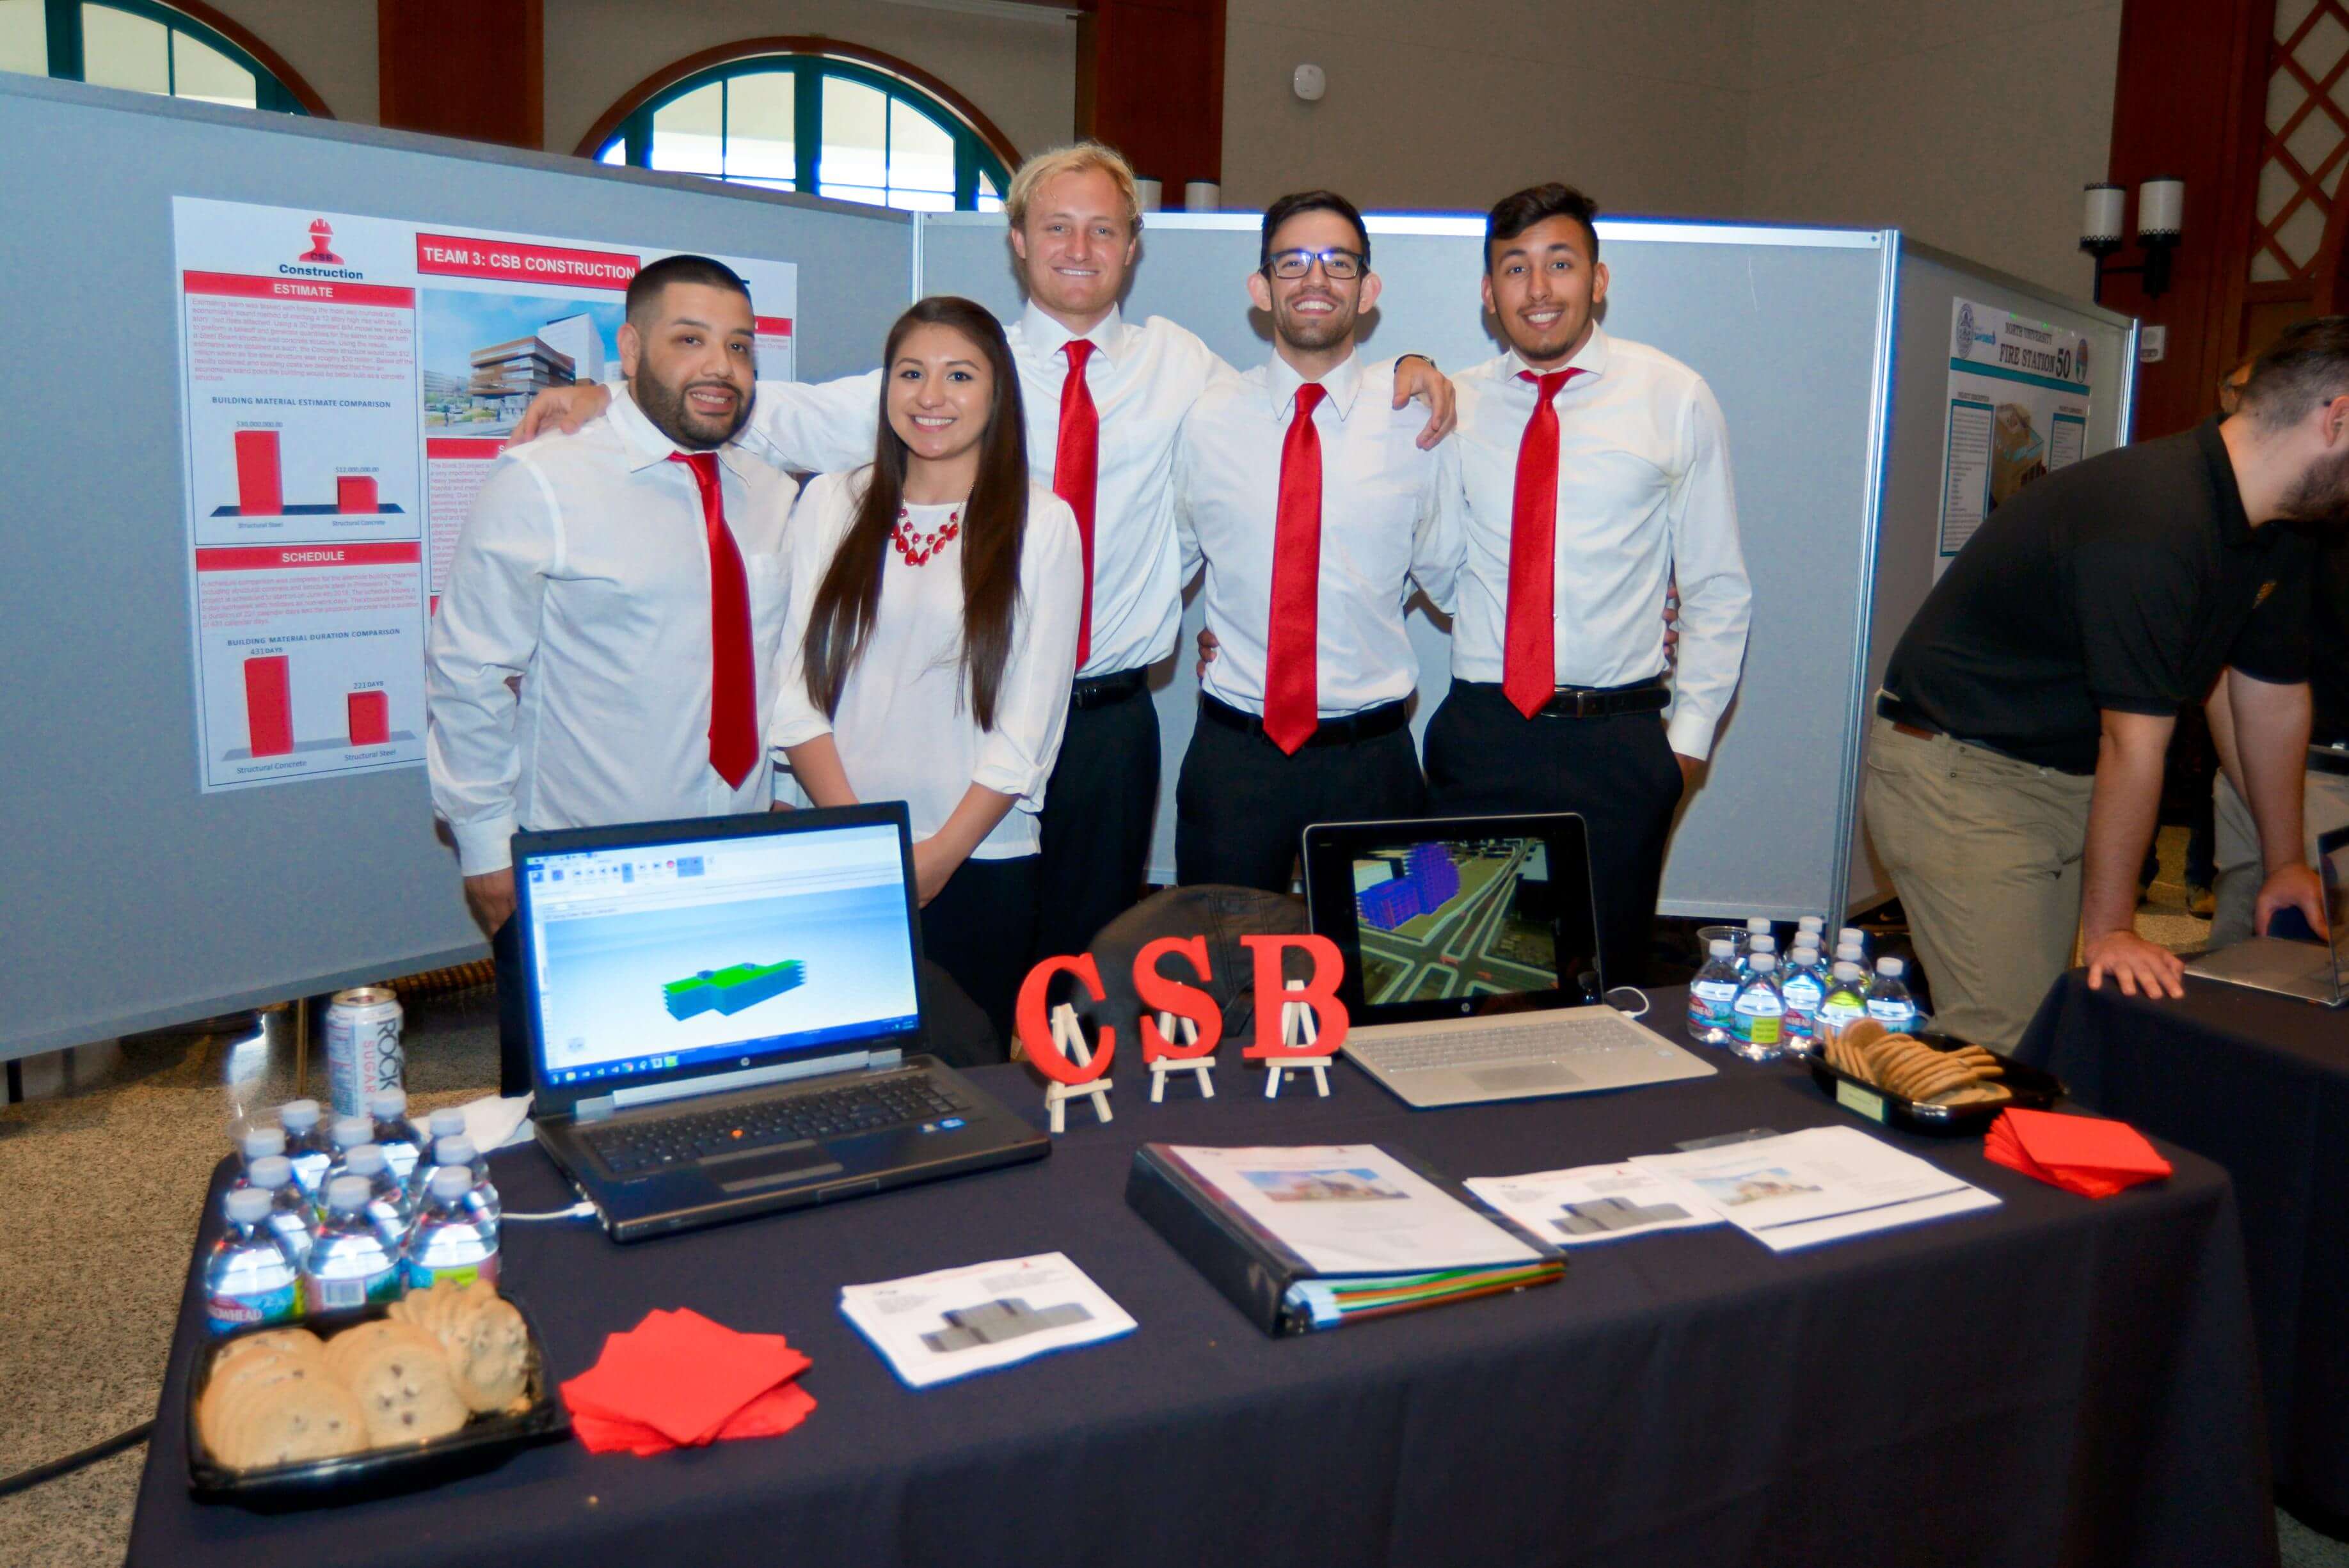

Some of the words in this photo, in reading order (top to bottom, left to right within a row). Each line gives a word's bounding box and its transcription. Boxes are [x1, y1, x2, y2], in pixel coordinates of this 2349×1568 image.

[311, 253, 333, 262] CSB
[424, 247, 468, 264] TEAM
[473, 252, 486, 266] 3:
[490, 254, 522, 269] CSB
[525, 257, 635, 279] CONSTRUCTION
[279, 264, 363, 279] Construction
[274, 283, 333, 297] ESTIMATE
[2024, 327, 2052, 345] UNIVERSITY
[1999, 344, 2019, 365] FIRE
[2021, 349, 2055, 373] STATION
[2056, 348, 2071, 379] 50
[282, 551, 345, 563] SCHEDULE
[227, 637, 266, 646] BUILDING
[269, 635, 308, 643] MATERIAL
[310, 632, 349, 640] DURATION
[352, 628, 400, 637] COMPARISON
[345, 752, 378, 761] Structural
[237, 764, 273, 774] Structural
[275, 761, 307, 769] Concrete
[363, 1040, 376, 1093] SUGAR
